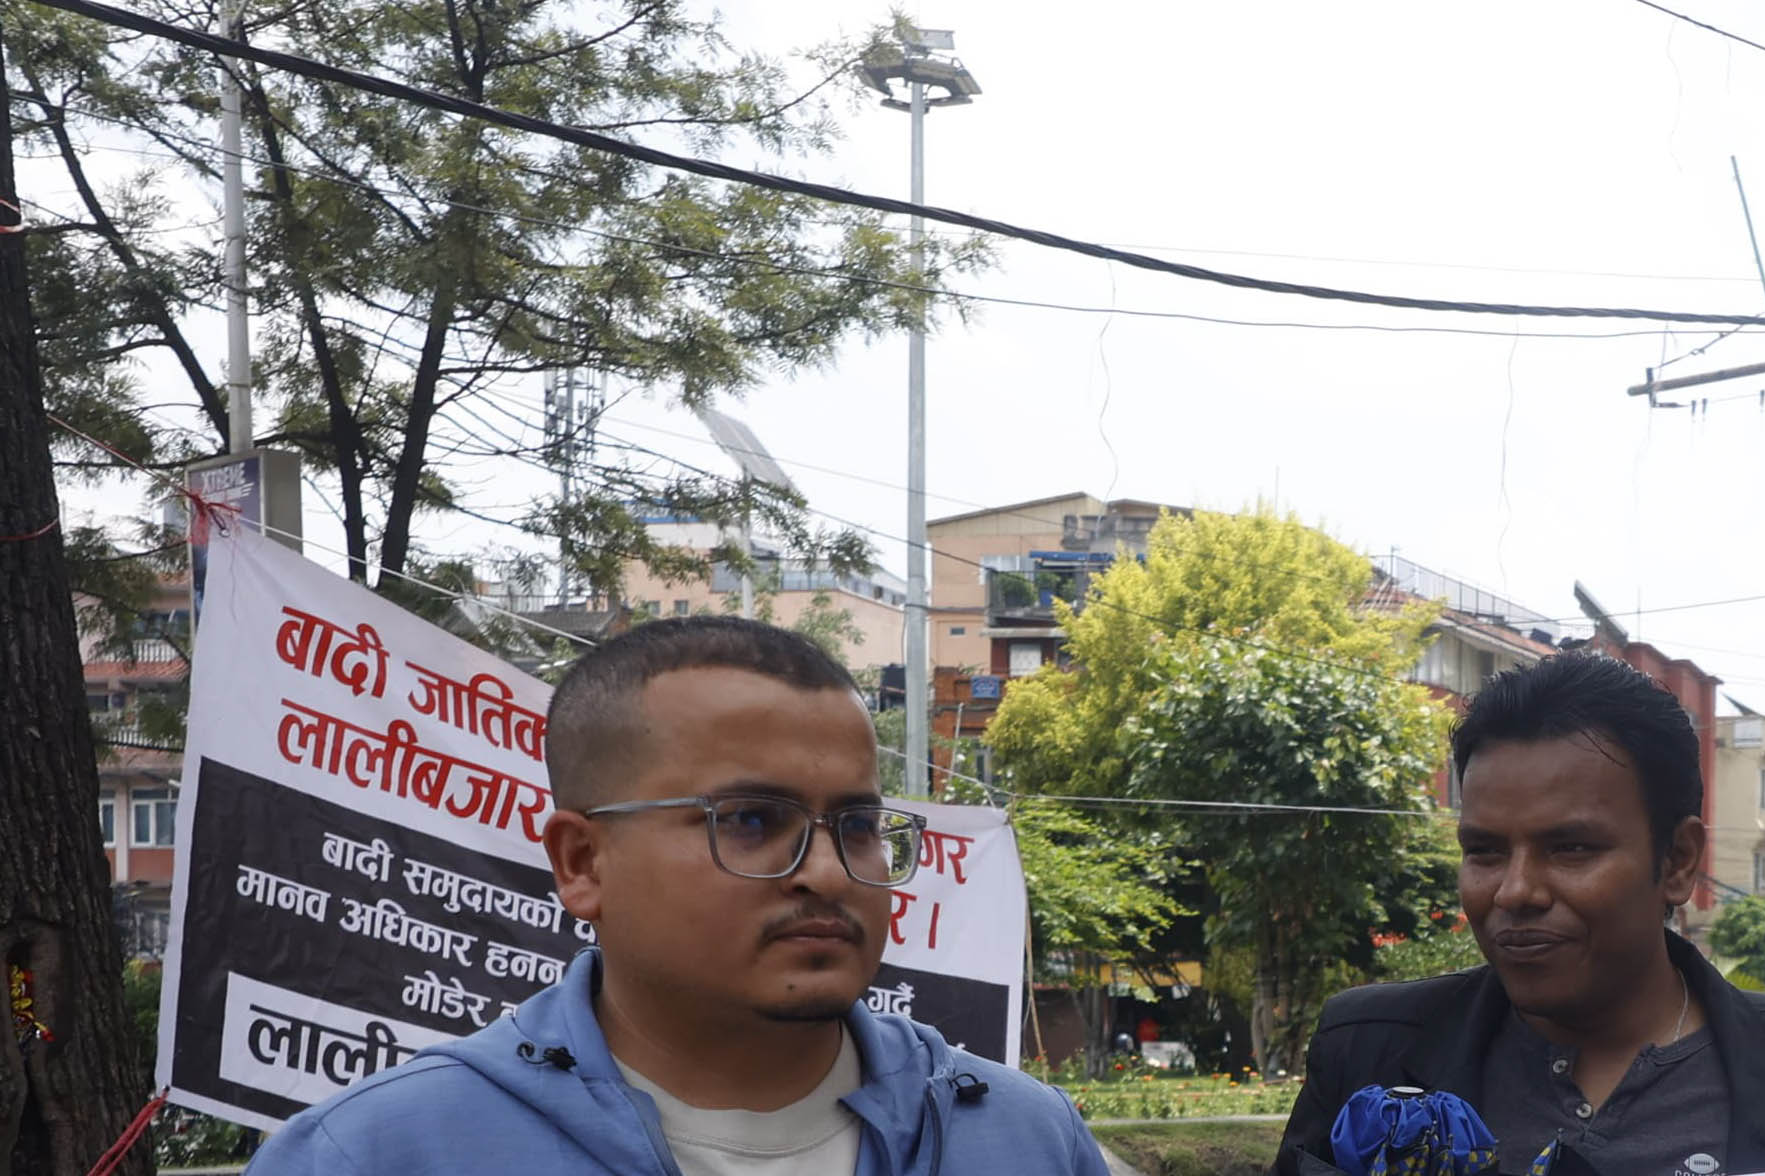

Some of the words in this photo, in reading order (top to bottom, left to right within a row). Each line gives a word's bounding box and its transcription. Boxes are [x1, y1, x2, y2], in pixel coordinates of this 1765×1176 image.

[276, 605, 391, 698] बादी
[278, 697, 553, 843] लालीबजार
[236, 864, 331, 923] मानव
[338, 898, 478, 967] अधिकार
[485, 941, 566, 986] हनन
[322, 832, 394, 882] बादी
[403, 858, 566, 934] समुदायको
[402, 970, 492, 1028] मोडेर
